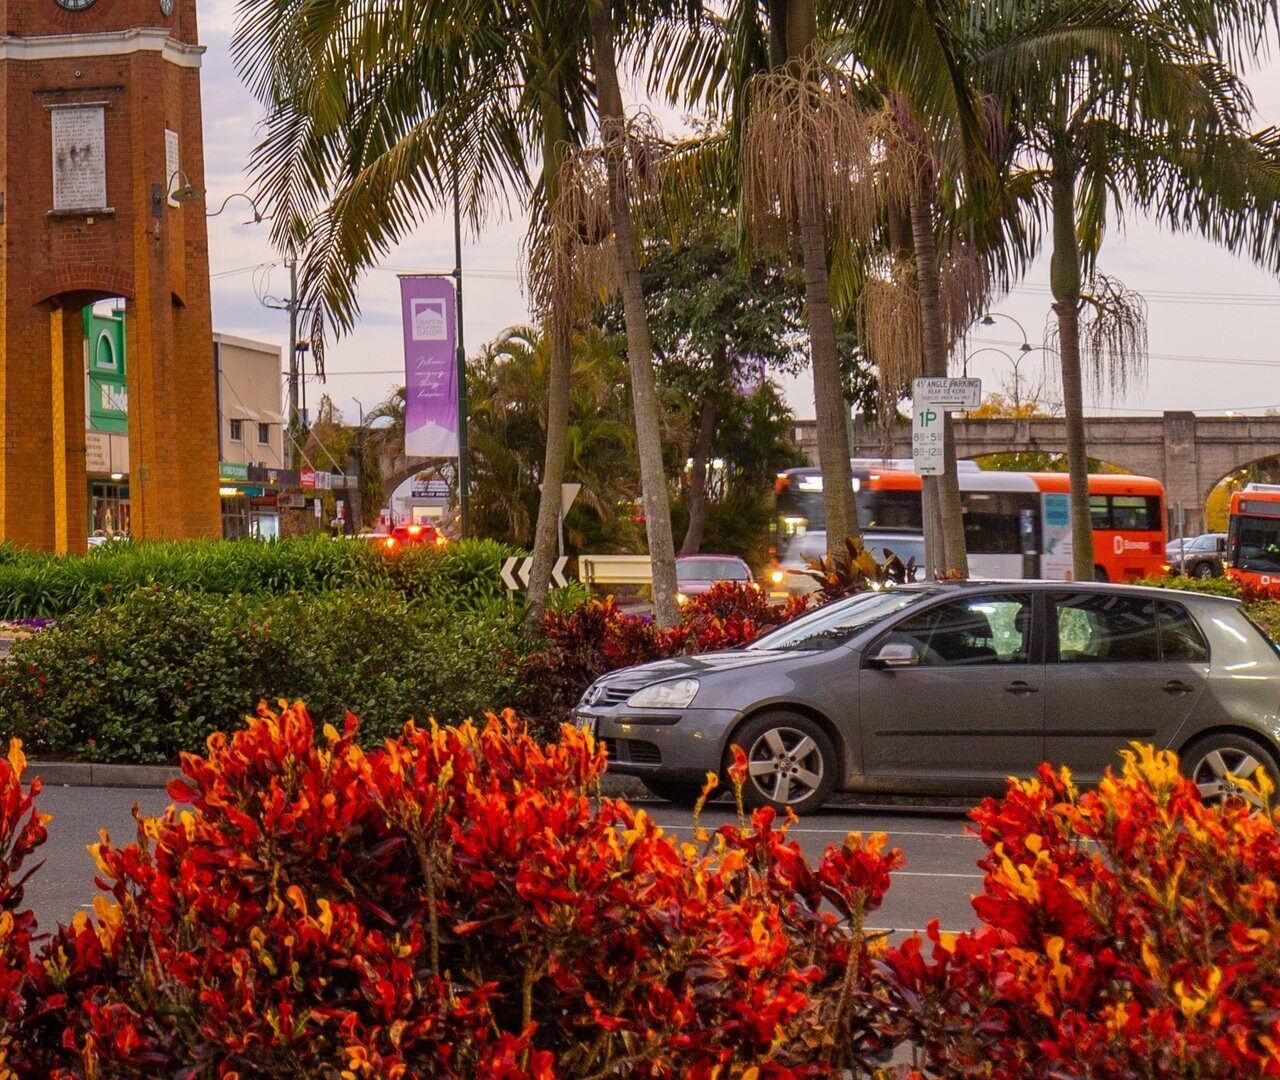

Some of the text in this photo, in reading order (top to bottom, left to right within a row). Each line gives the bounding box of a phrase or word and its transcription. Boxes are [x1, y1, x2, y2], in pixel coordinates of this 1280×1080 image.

[926, 380, 947, 388] ANGLE
[948, 380, 979, 388] PARKING
[919, 411, 937, 428] 1P
